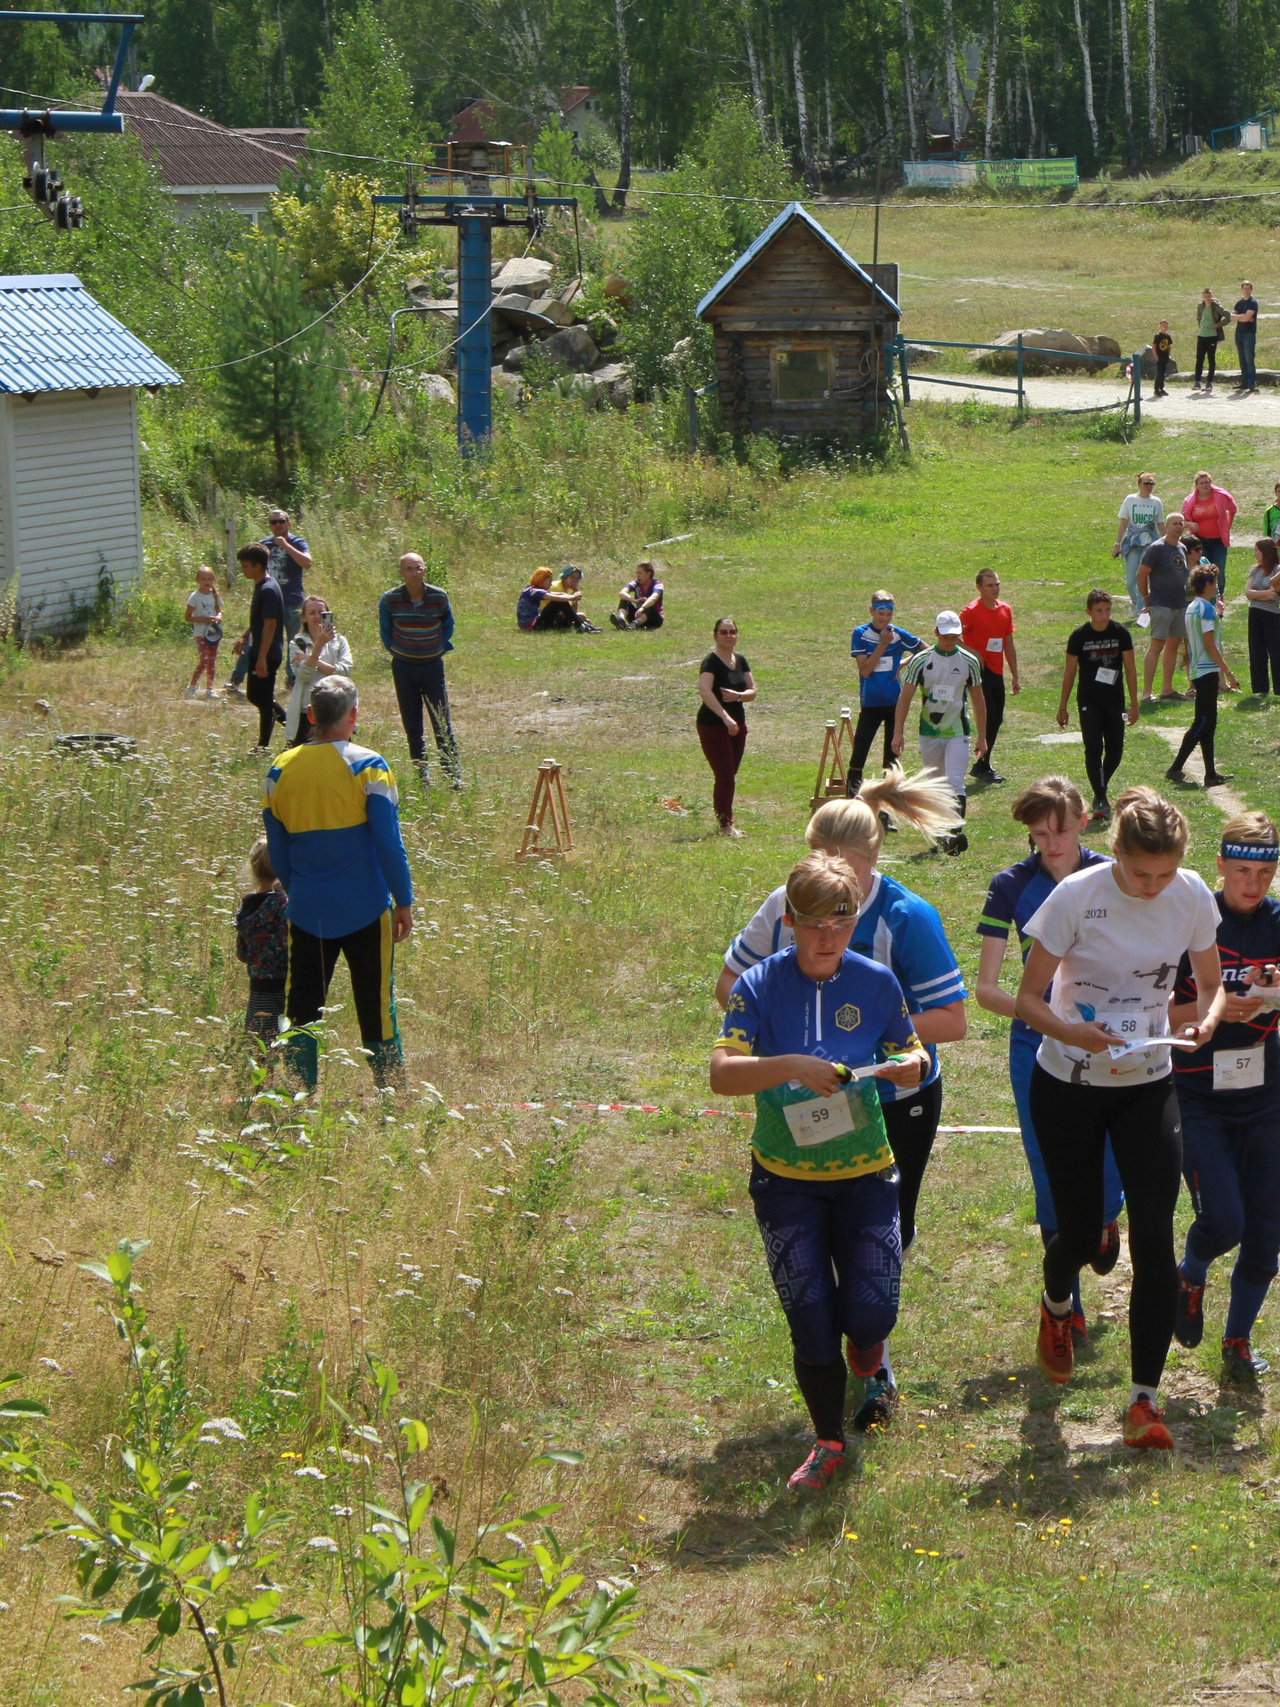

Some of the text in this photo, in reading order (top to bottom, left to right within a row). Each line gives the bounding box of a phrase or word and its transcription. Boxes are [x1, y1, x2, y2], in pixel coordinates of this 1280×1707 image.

[1085, 908, 1107, 919] 2021
[1121, 1021, 1137, 1032] 58
[1236, 1057, 1251, 1069] 57
[811, 1108, 829, 1123] 59
